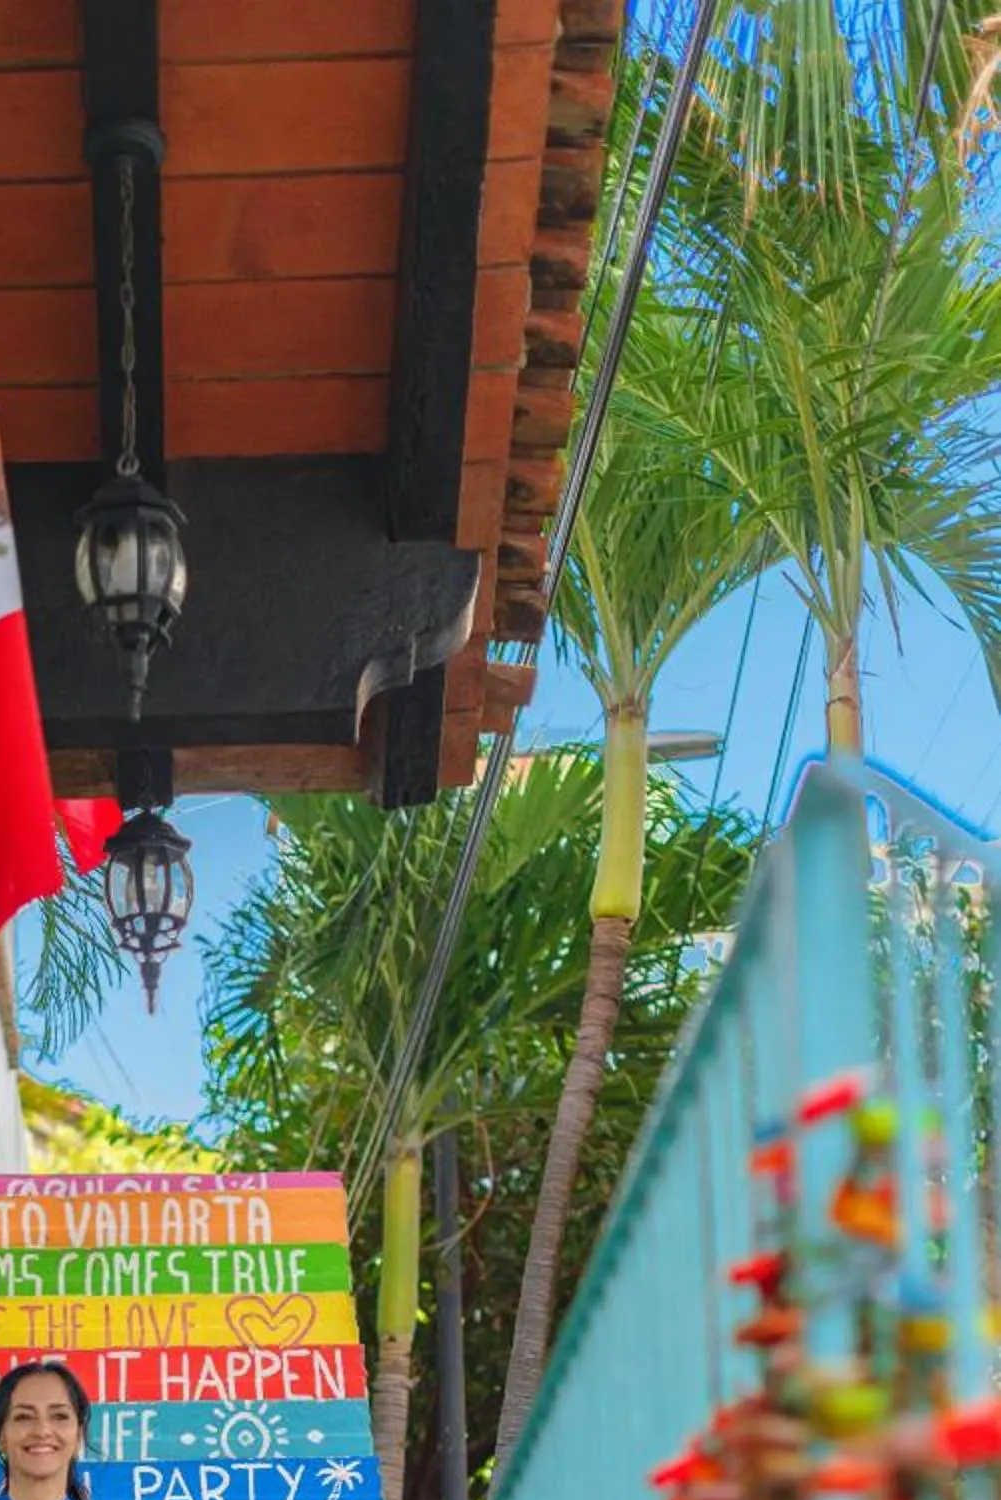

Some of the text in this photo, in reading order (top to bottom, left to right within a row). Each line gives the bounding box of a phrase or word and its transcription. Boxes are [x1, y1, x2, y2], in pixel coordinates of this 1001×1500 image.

[64, 1196, 272, 1249] VALLARTA
[57, 1250, 189, 1297] COMES
[202, 1249, 307, 1296] TRUE
[18, 1303, 83, 1347] THE
[103, 1301, 197, 1347] LOVE
[97, 1350, 142, 1404] IT
[160, 1347, 345, 1403] HAPPEN
